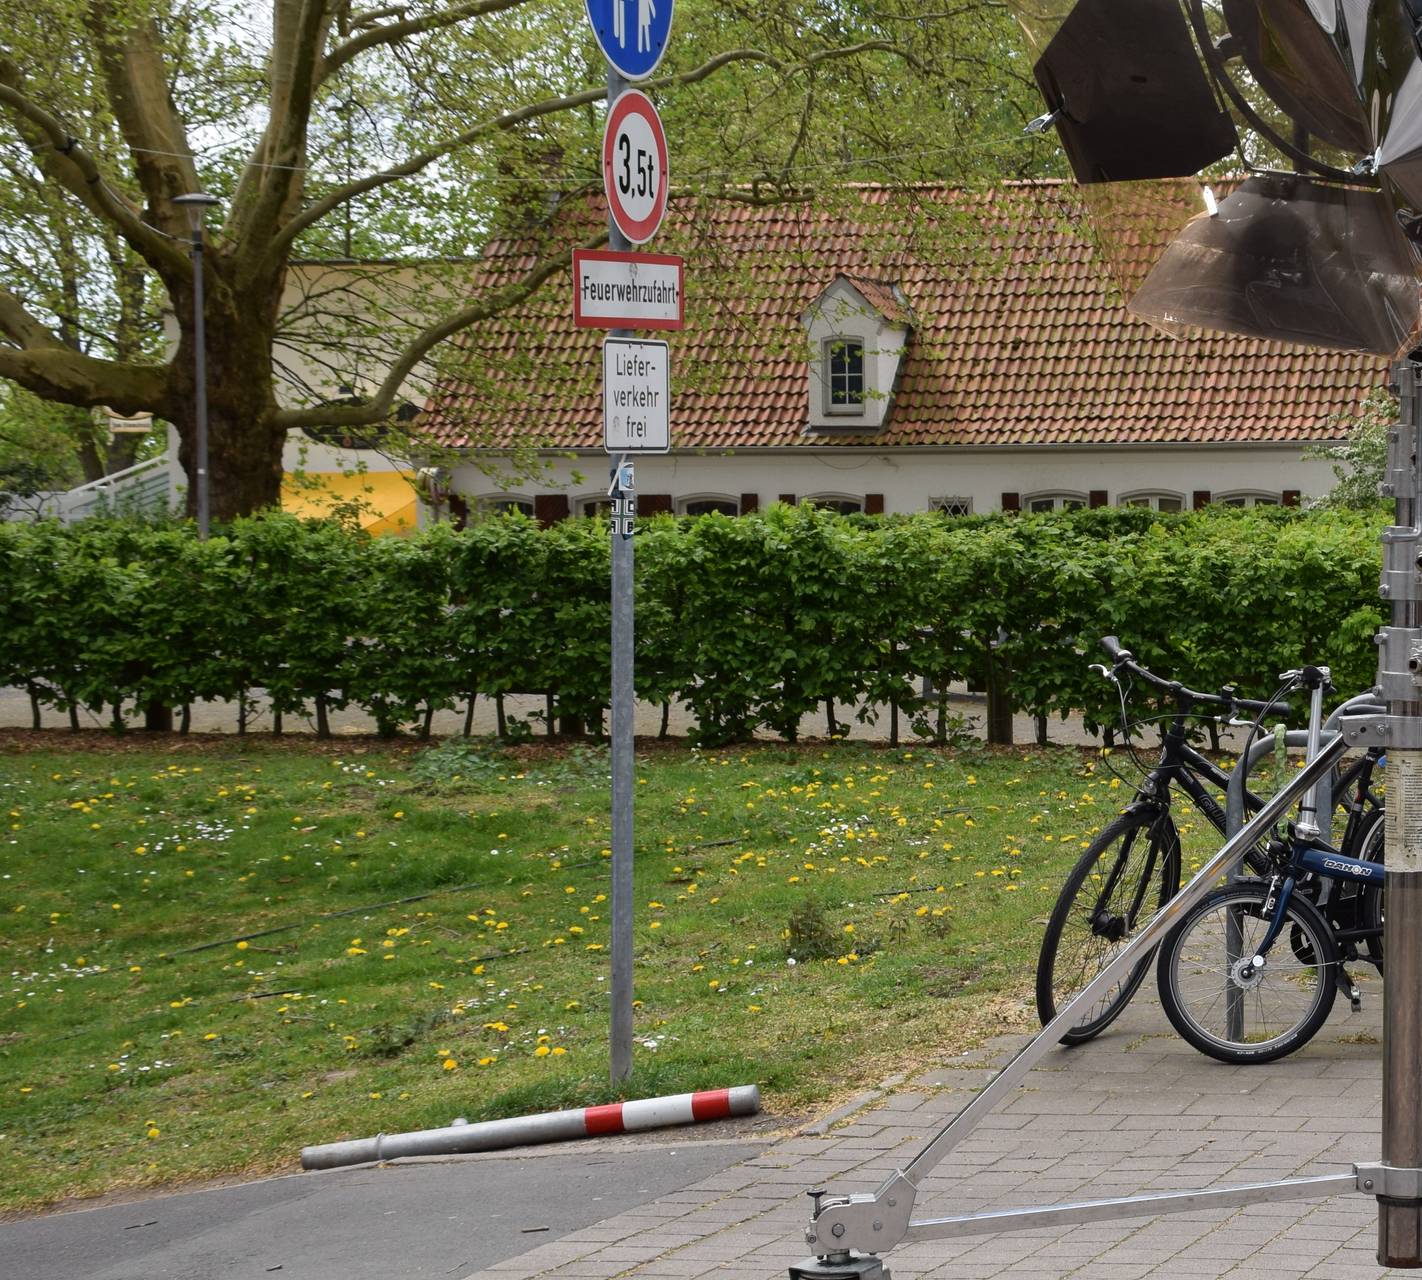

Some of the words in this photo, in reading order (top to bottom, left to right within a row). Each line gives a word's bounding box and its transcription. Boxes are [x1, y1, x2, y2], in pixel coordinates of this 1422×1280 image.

[619, 133, 654, 198] 3,5t
[583, 276, 676, 304] Feuerwehrzufahrt
[616, 353, 656, 377] Liefer-
[613, 385, 659, 407] verkehr
[626, 415, 647, 438] frei
[1324, 860, 1372, 876] DAHON
